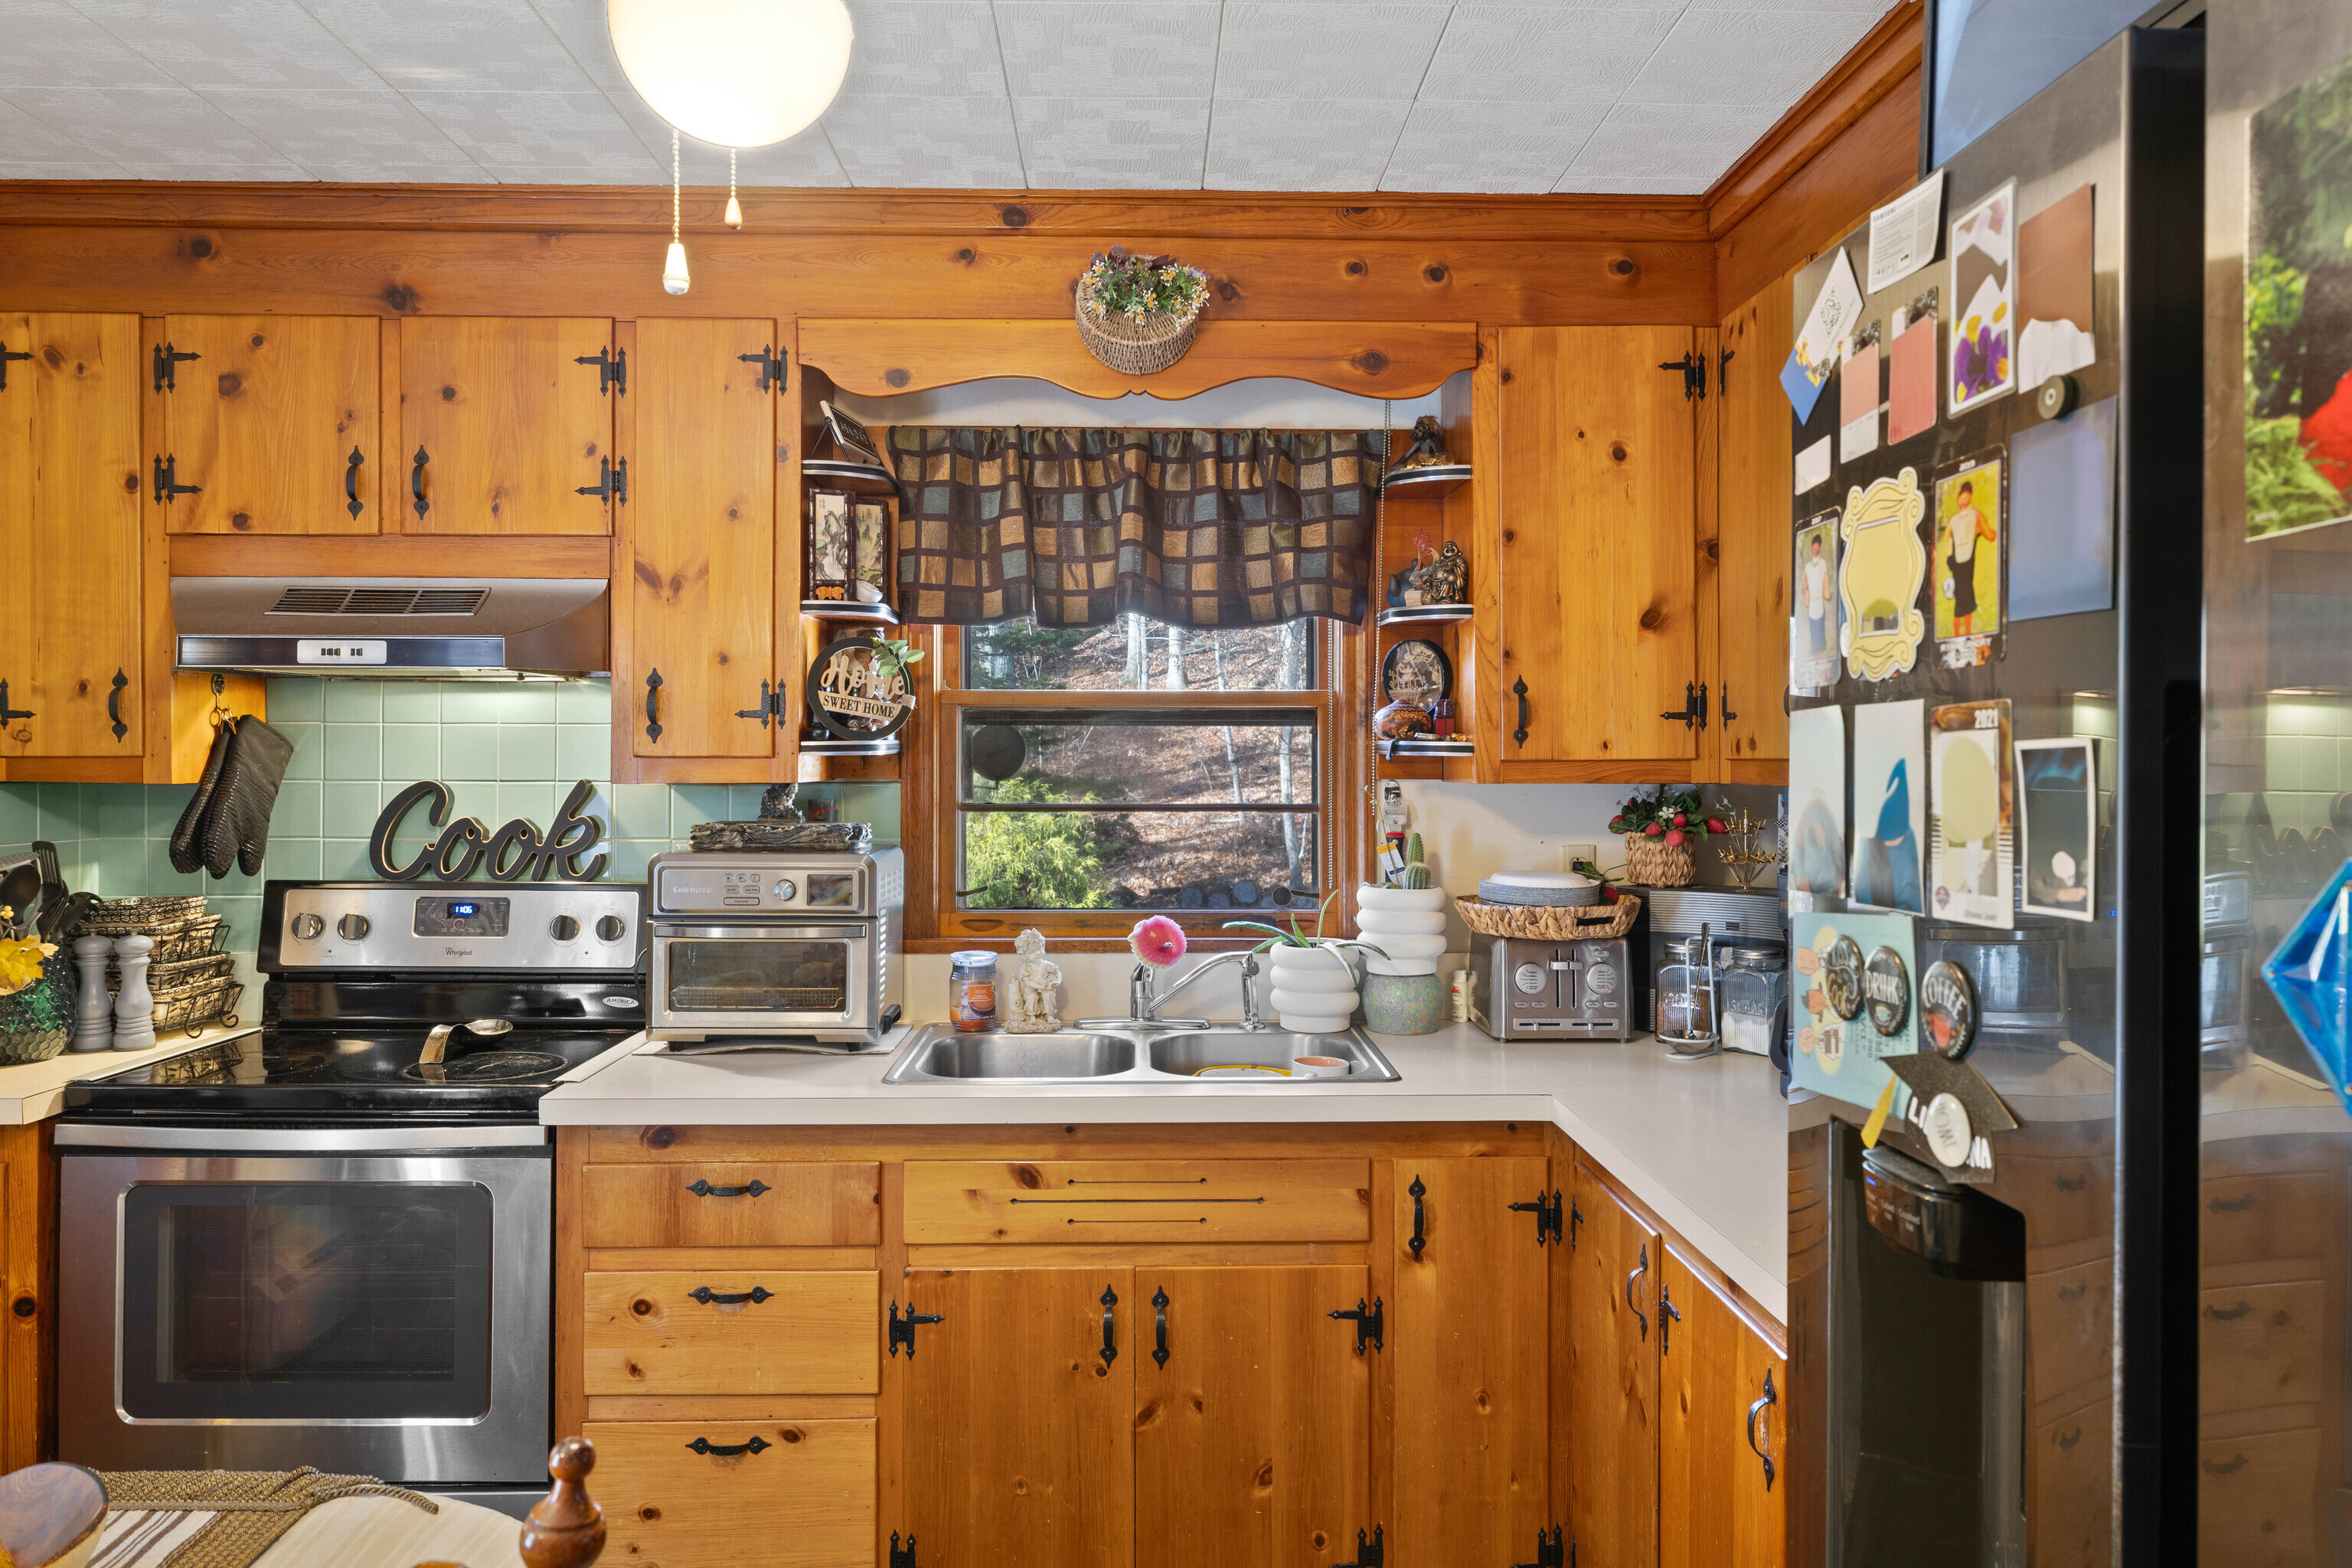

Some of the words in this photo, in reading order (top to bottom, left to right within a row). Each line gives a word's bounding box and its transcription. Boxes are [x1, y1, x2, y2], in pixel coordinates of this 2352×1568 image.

[821, 655, 905, 700] Home
[823, 695, 861, 712] SWEET
[864, 701, 895, 718] HOME
[1975, 709, 1998, 729] 2021
[370, 779, 603, 881] Cook
[1865, 970, 1900, 1005] DRINK
[1922, 976, 1968, 1020] COFFEE
